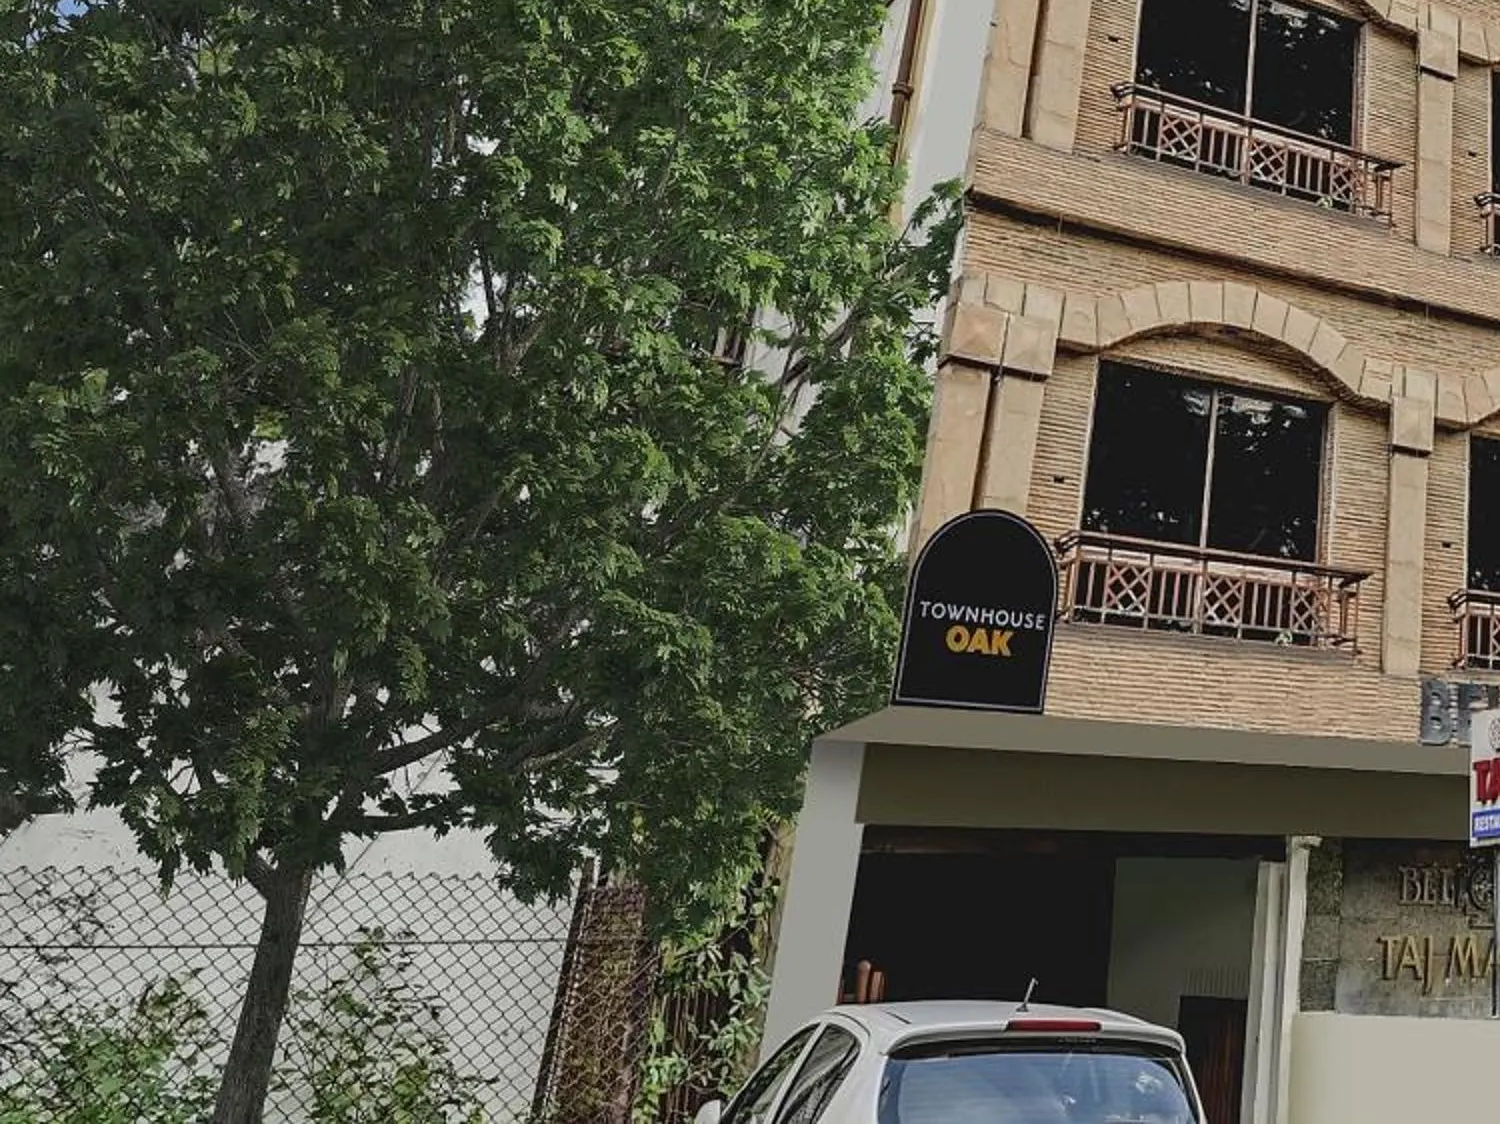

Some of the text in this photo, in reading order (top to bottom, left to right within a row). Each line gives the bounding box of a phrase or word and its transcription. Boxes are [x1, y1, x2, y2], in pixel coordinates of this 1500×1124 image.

[919, 601, 1047, 631] TOWNHOUSE
[945, 624, 1015, 657] OAK
[1378, 933, 1433, 997] TAJ
